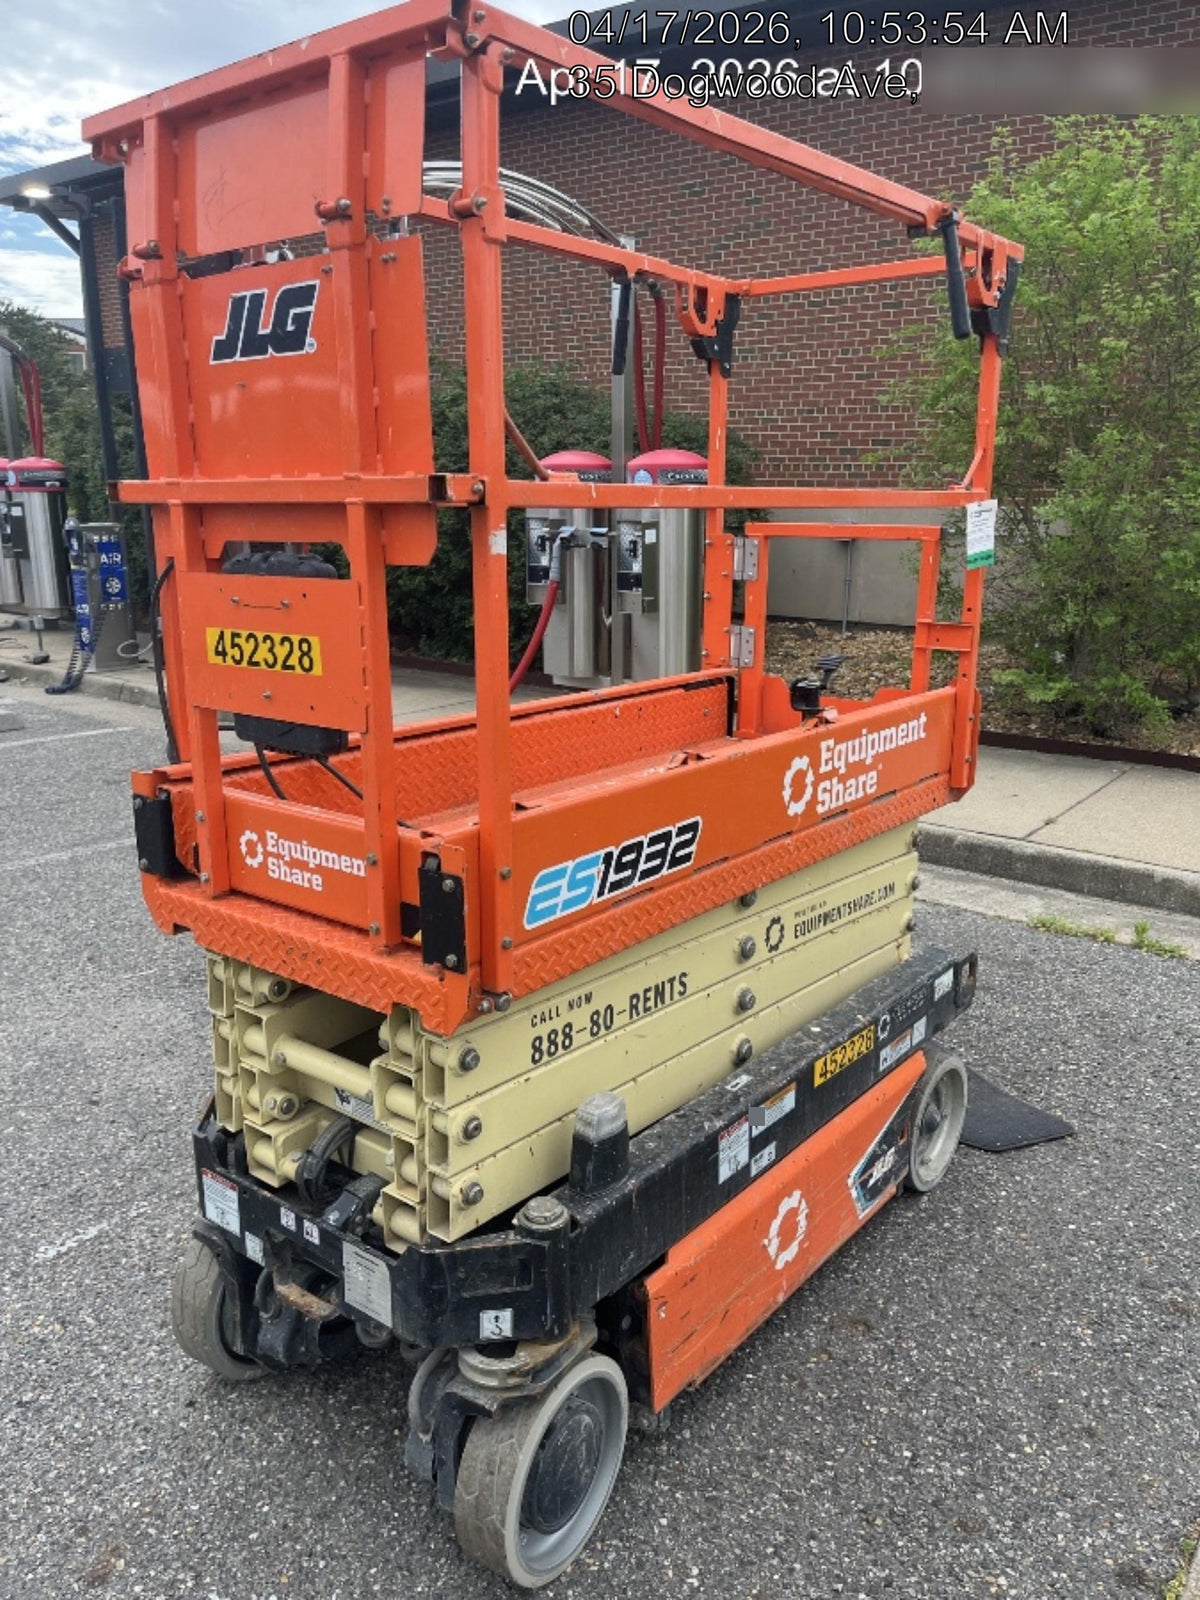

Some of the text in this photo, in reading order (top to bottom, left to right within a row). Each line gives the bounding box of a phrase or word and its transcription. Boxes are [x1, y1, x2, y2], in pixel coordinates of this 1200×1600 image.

[209, 279, 320, 365] JLG
[214, 630, 314, 673] 452328
[819, 711, 927, 774] Equipment
[816, 770, 878, 814] Share
[266, 830, 366, 877] Equipmen
[267, 856, 323, 892] Share
[523, 815, 702, 930] ES1932
[531, 991, 593, 1028] CALL NOW
[531, 971, 688, 1065] 888-80-RENTS
